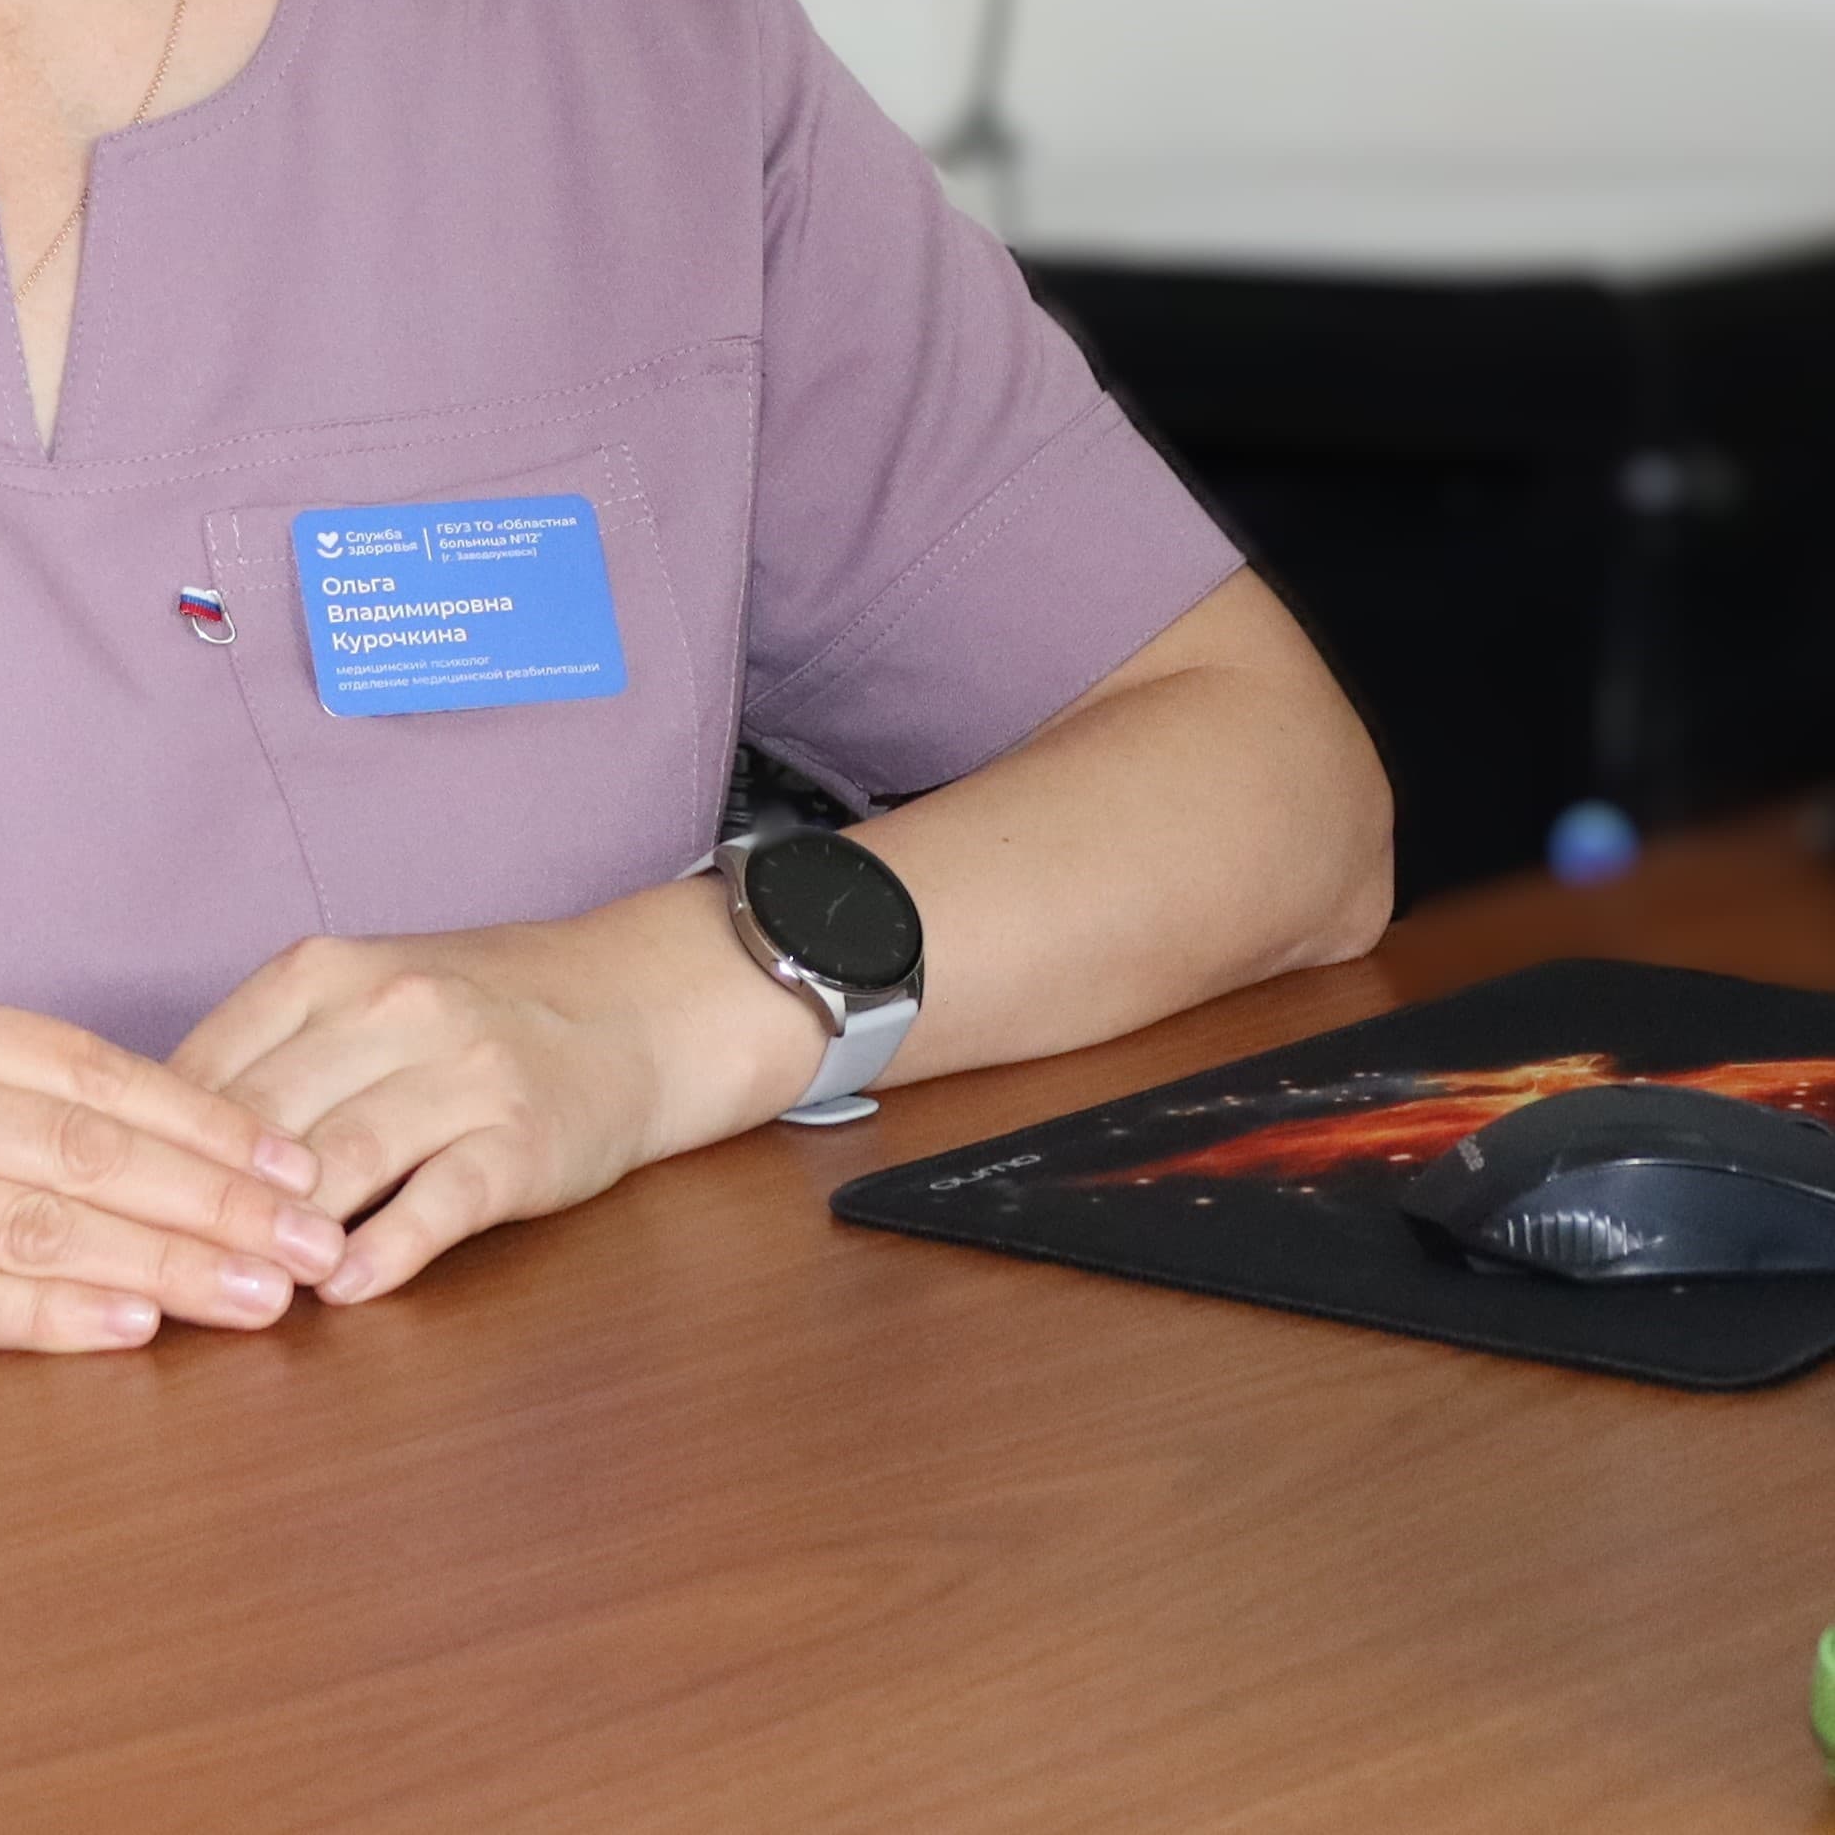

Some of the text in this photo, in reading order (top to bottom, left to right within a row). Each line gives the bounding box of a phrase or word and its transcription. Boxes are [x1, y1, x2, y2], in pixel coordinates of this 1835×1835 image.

[346, 528, 403, 544] Служба
[436, 521, 472, 535] ГБУЗ
[474, 520, 494, 533] ТО
[348, 541, 418, 557] здоровья
[439, 536, 508, 550] больница
[322, 576, 397, 596] Ольга
[327, 595, 514, 623] Владимировна
[332, 626, 468, 655] Курочкина
[336, 655, 491, 676] медицинский психолог
[412, 668, 503, 686] медицинской
[506, 663, 601, 681] реабилитации
